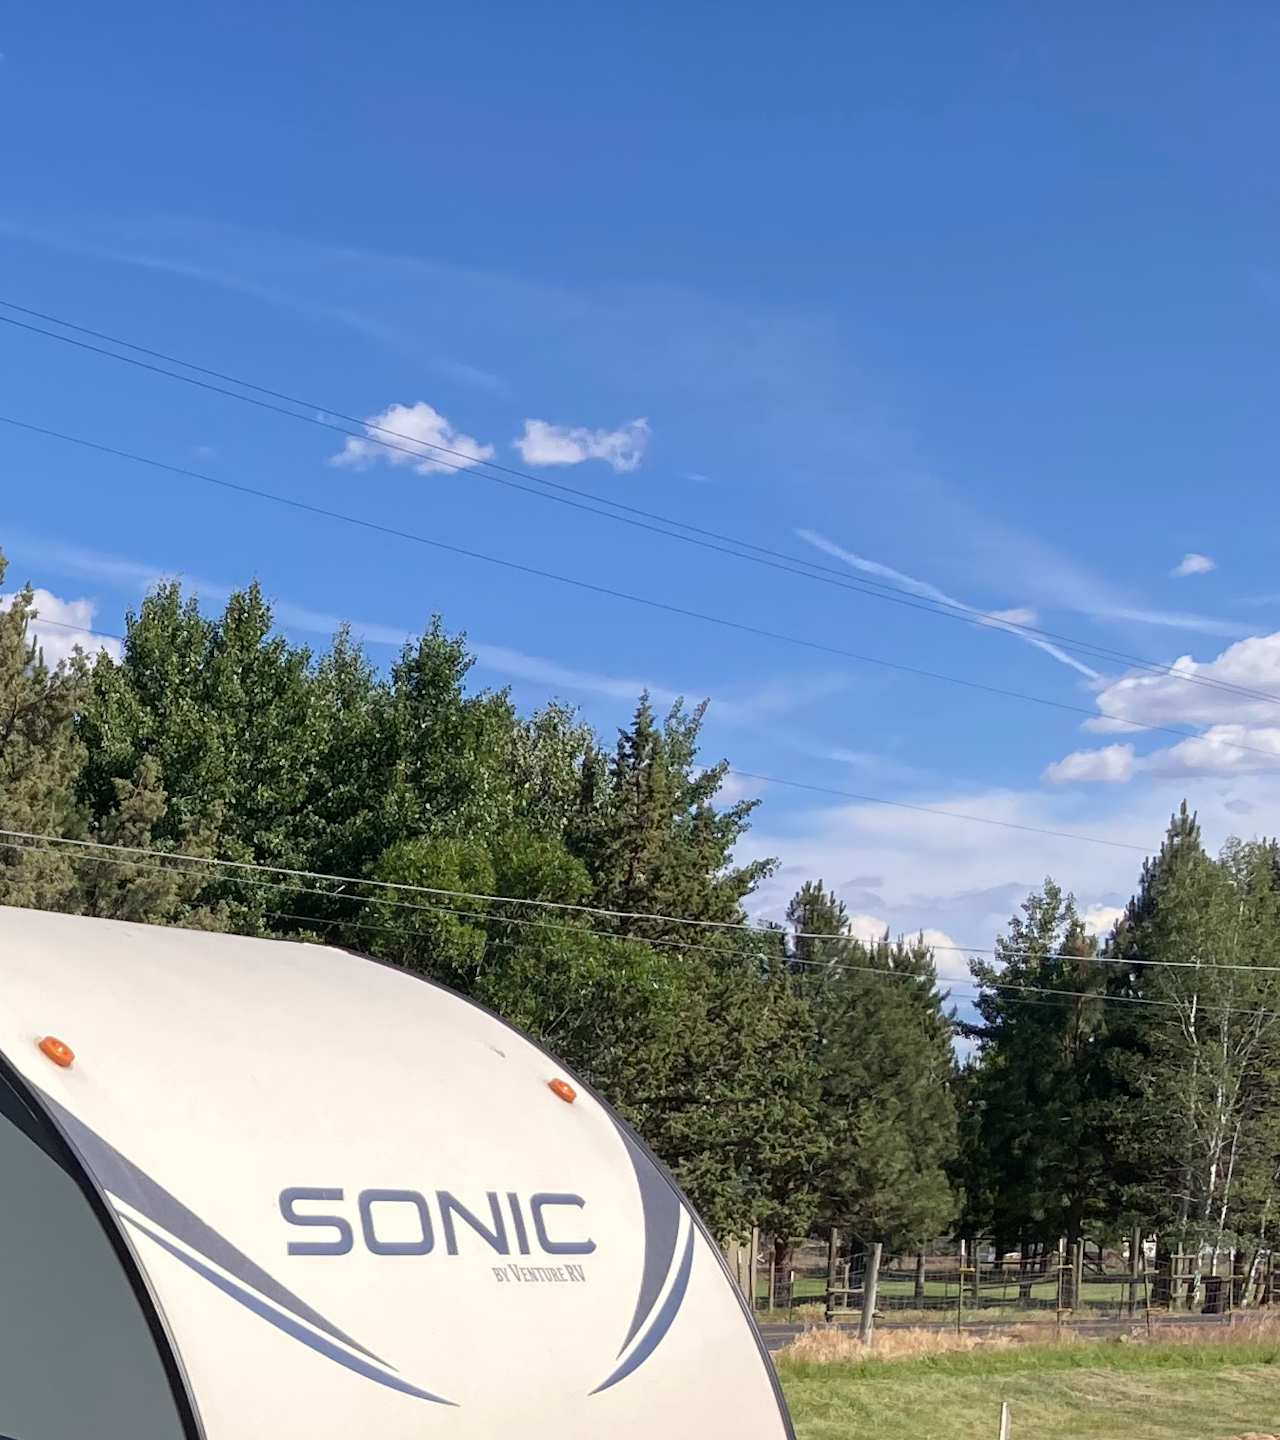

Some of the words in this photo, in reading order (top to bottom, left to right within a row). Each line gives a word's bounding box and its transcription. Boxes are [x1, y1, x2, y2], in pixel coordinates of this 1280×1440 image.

[278, 1186, 597, 1256] SONIC
[492, 1267, 511, 1282] BY
[507, 1264, 568, 1282] VENTURE
[563, 1264, 586, 1282] RV
